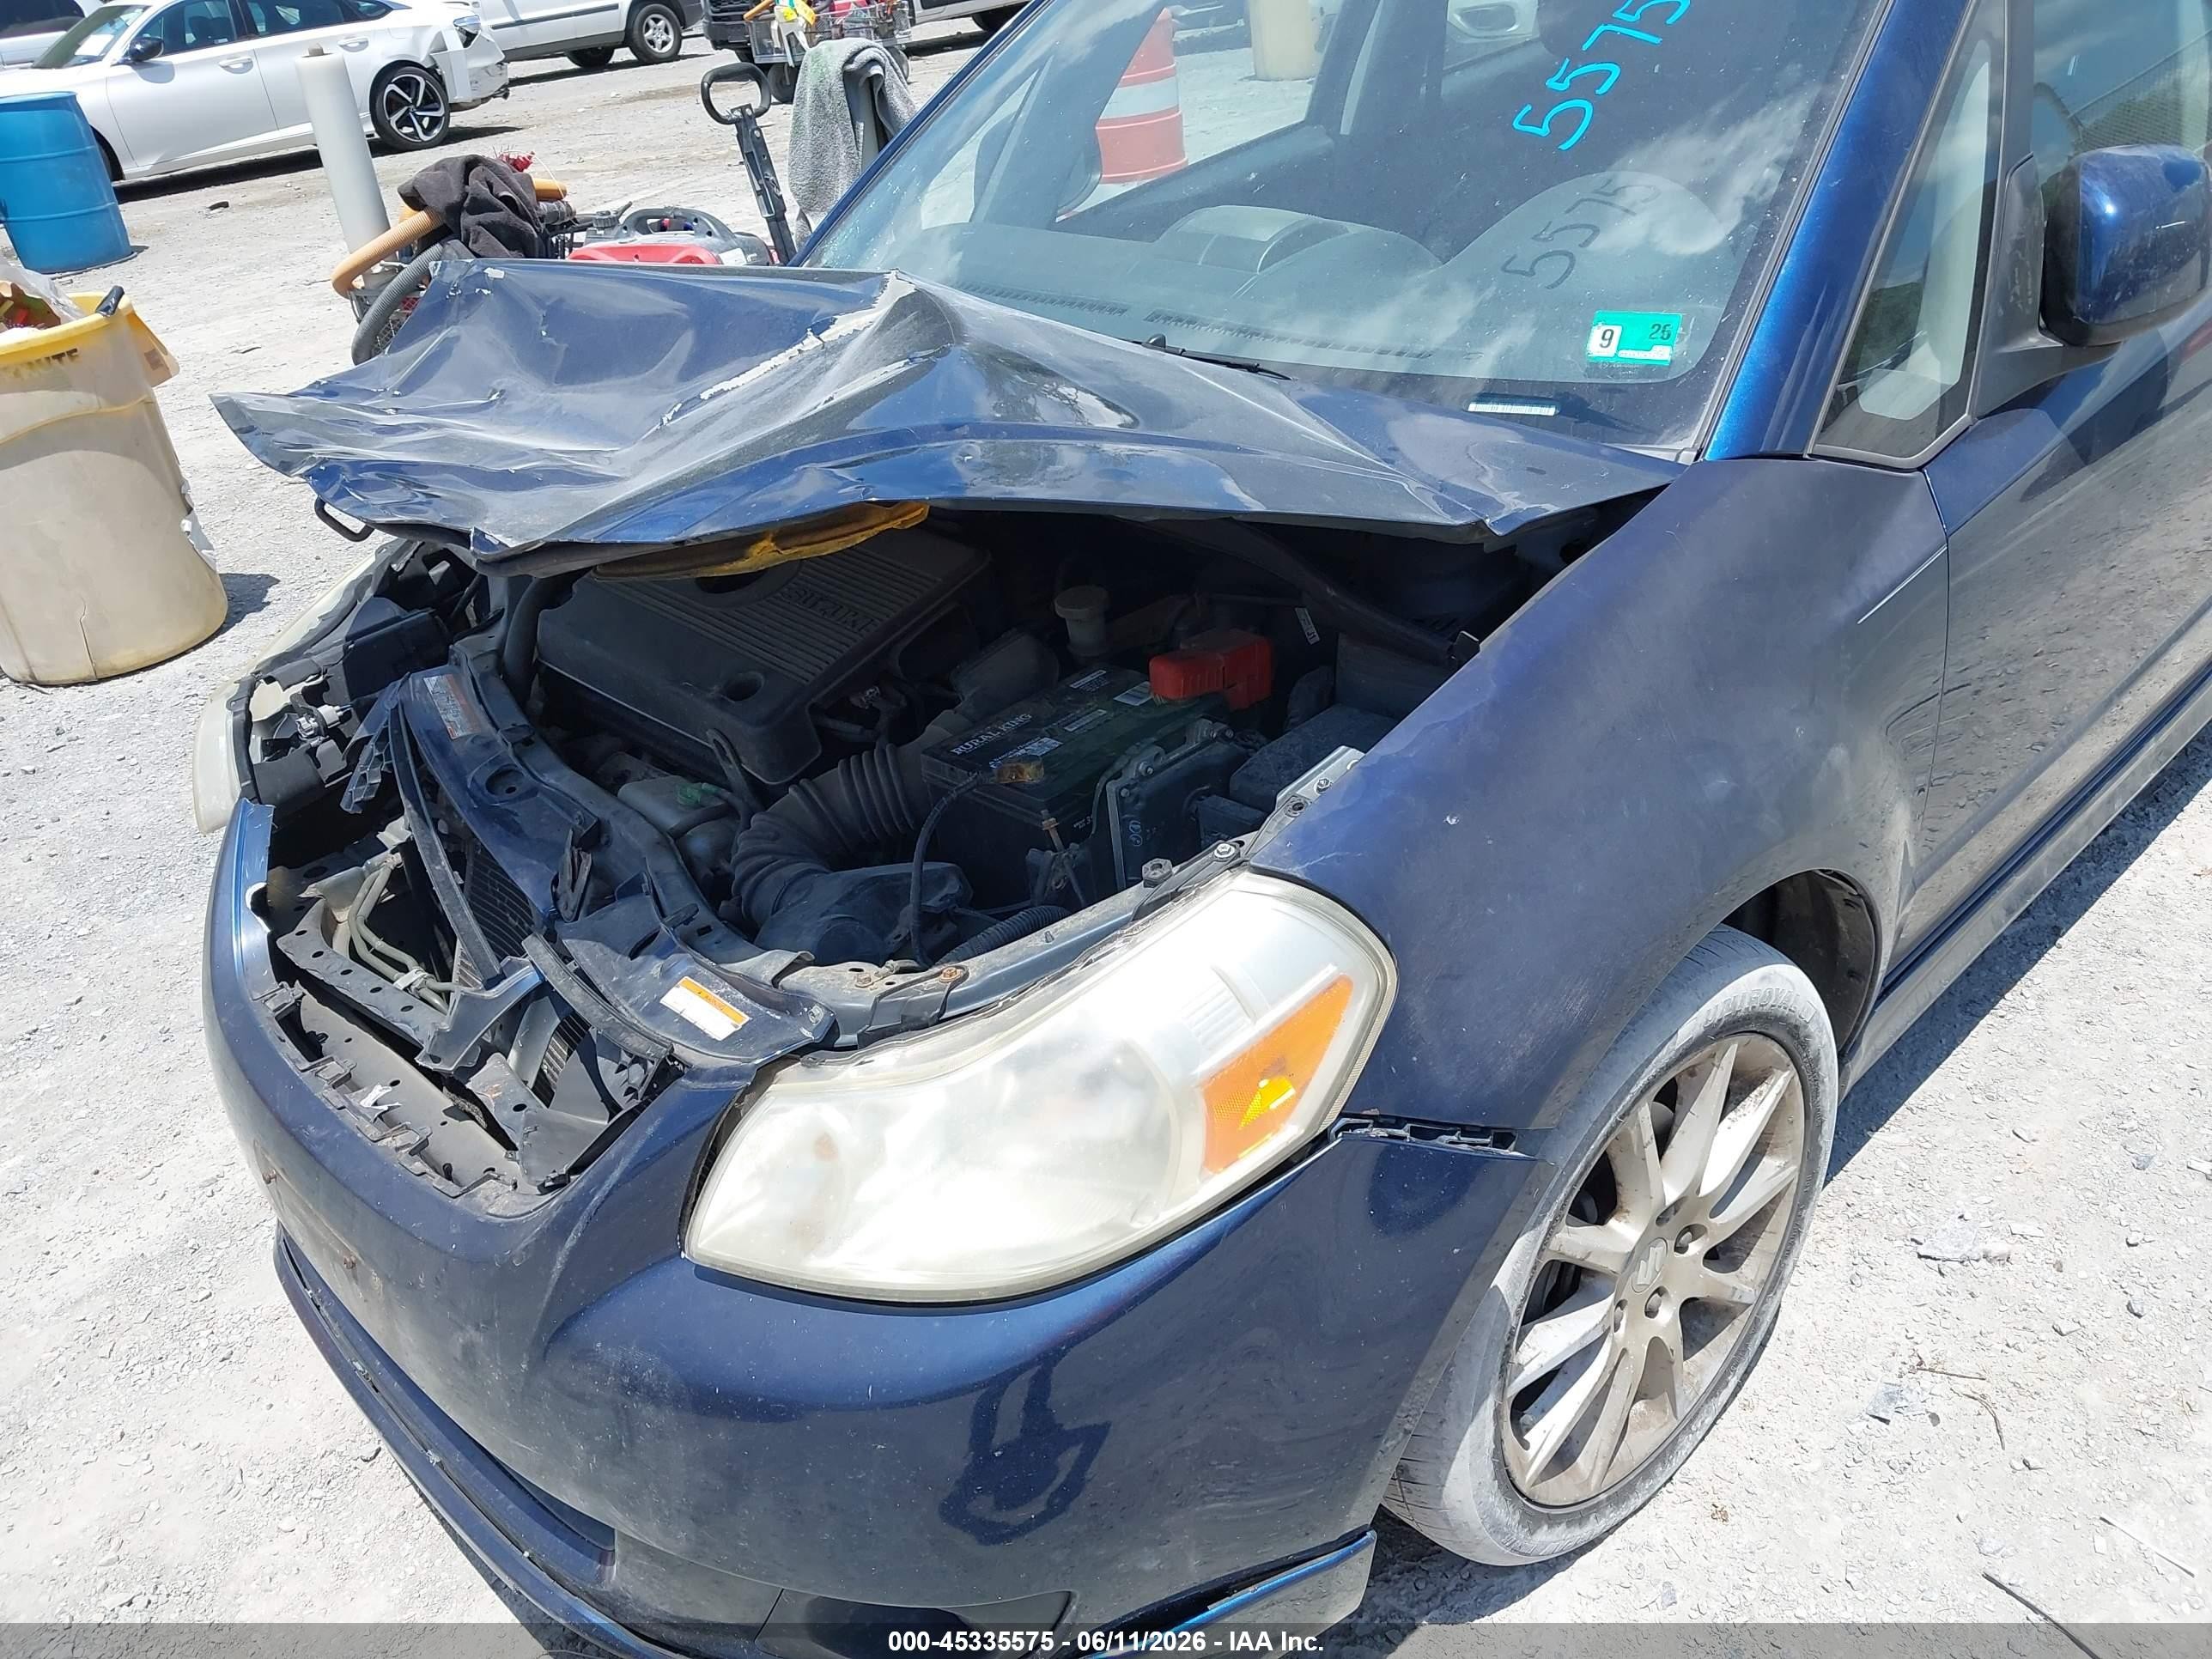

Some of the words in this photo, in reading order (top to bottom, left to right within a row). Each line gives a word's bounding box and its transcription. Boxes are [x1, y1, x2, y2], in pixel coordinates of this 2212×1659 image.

[1512, 0, 1690, 150] 5575
[1599, 328, 1614, 349] 9
[781, 587, 879, 632] SUZUKI
[950, 725, 1002, 756] RURAL
[998, 712, 1033, 736] KING
[1704, 988, 1800, 1028] UNIROYAL
